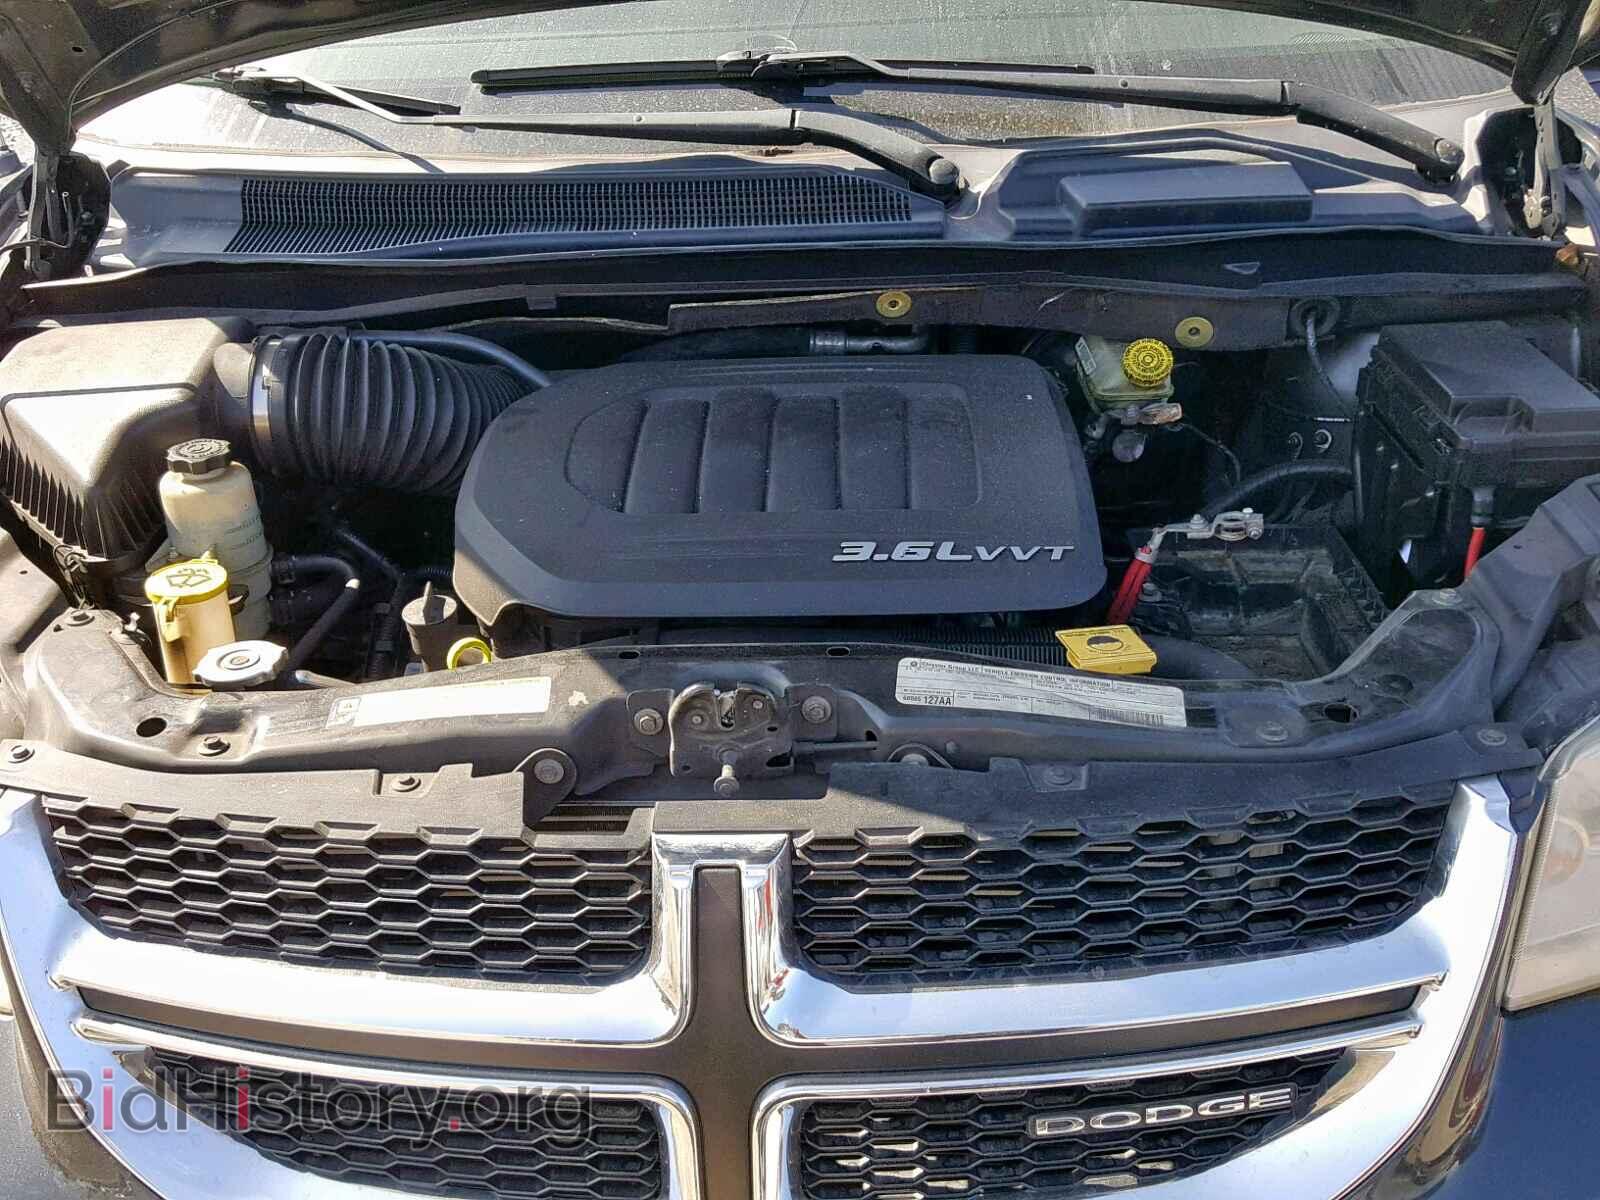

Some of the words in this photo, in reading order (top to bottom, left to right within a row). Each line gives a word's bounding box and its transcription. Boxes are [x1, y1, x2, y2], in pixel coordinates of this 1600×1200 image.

[832, 541, 973, 562] 3.6L
[975, 545, 1075, 561] VVT
[923, 696, 952, 705] 127AA
[1036, 1087, 1292, 1136] DODGE
